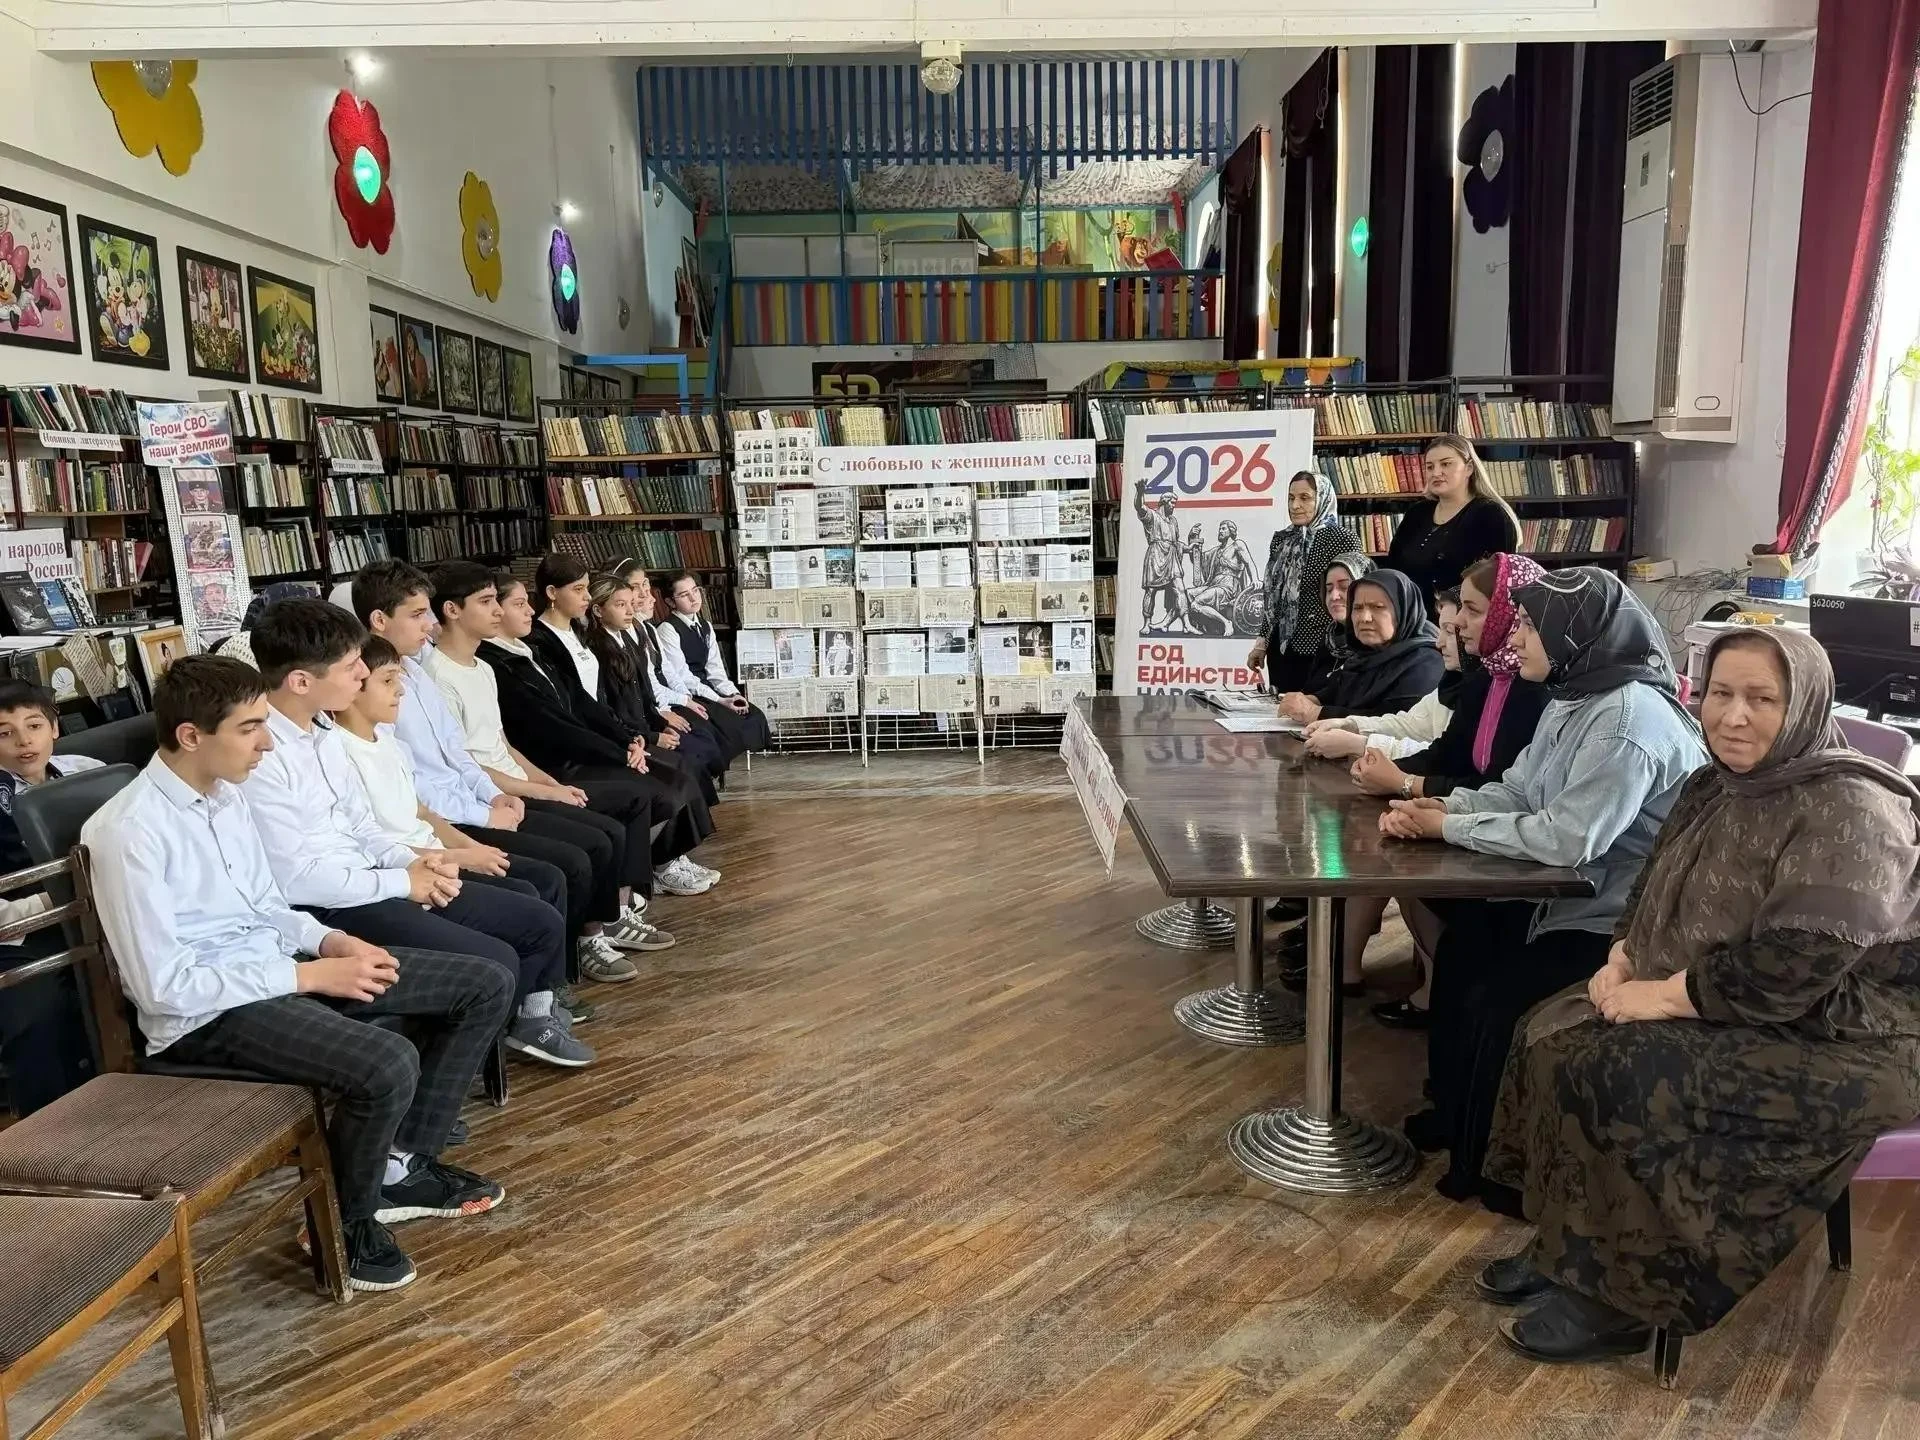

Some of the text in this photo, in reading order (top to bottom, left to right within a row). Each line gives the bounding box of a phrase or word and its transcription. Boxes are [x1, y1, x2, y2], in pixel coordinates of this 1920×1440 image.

[150, 421, 181, 437] Герои
[183, 416, 207, 431] СВО
[43, 433, 121, 448] Новинки литературы
[149, 439, 228, 459] наши земляки
[818, 454, 1092, 473] С любовью к женщинам села
[1144, 443, 1276, 494] 2026
[7, 542, 65, 562] народов
[25, 562, 73, 579] России
[1138, 644, 1184, 664] ГОД
[1137, 666, 1265, 686] ЕДИНСТВА
